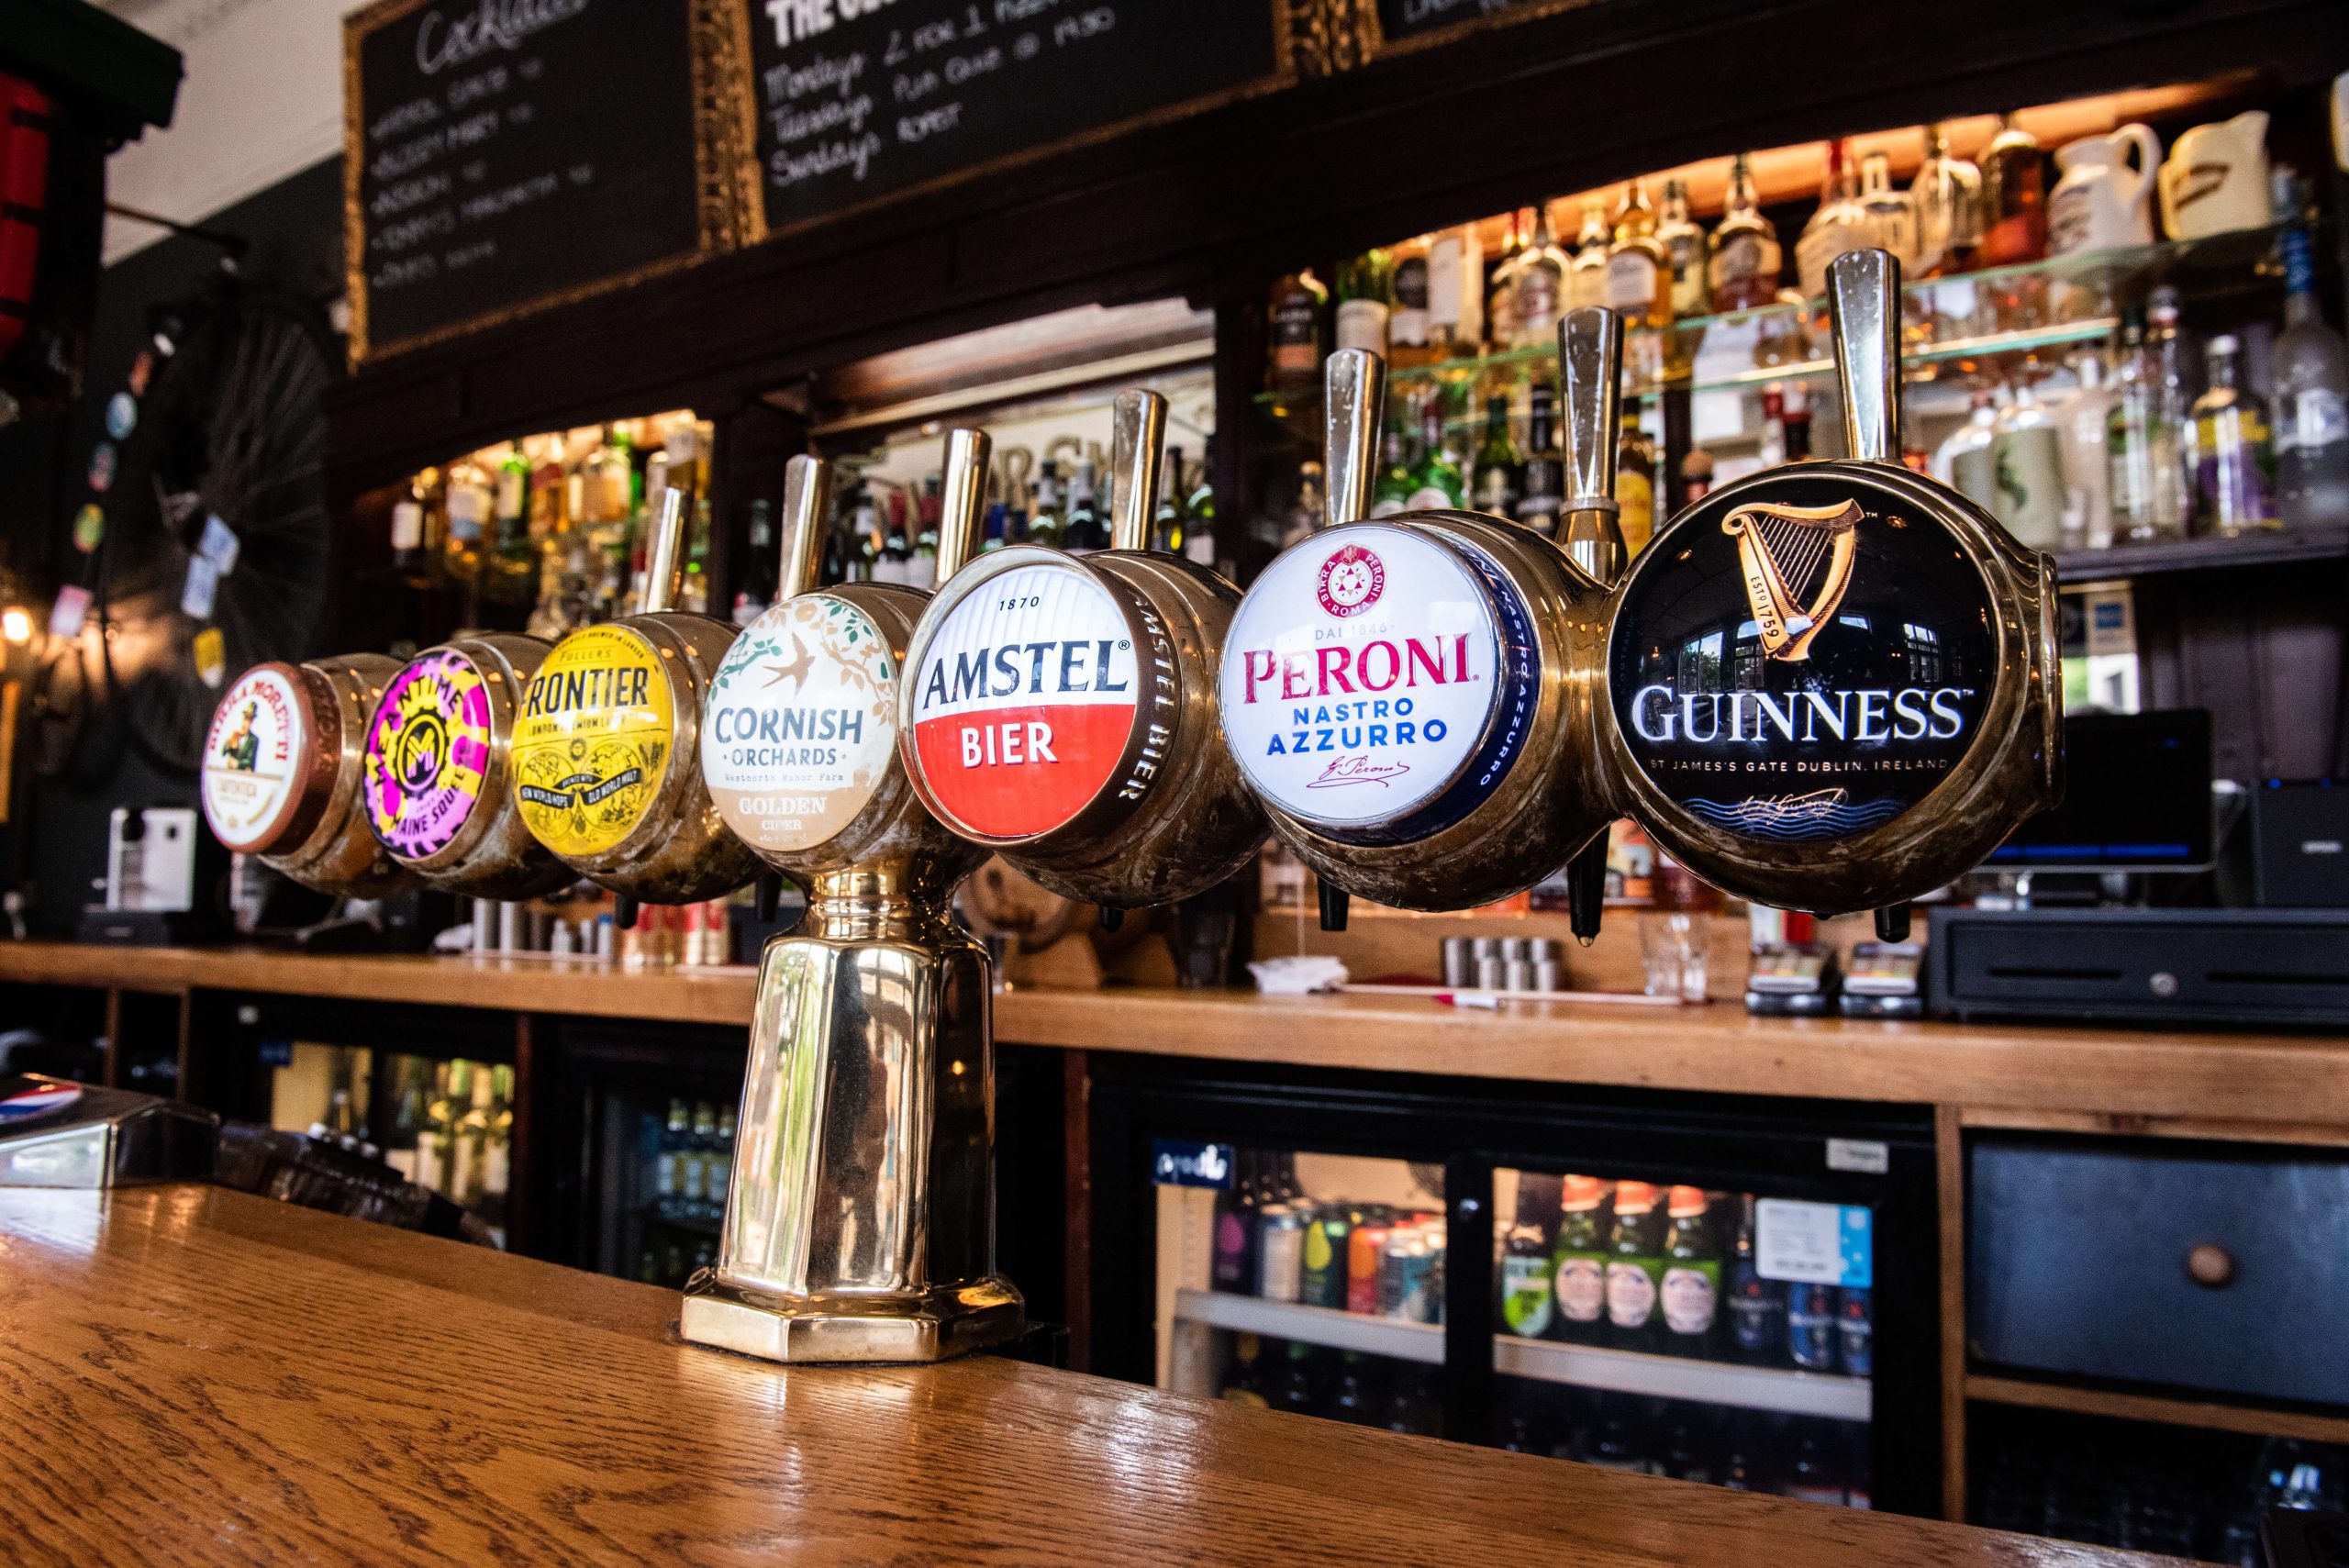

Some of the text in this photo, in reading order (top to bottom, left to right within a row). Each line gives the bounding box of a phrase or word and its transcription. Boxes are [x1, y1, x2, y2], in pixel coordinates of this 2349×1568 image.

[417, 0, 588, 75] Cockta
[764, 0, 836, 47] THE
[1319, 553, 1384, 603] BIRRA PERONI
[998, 596, 1040, 611] 1870
[1330, 601, 1370, 617] ROMA
[1756, 605, 1779, 639] 1759
[1315, 627, 1342, 640] DAL
[1501, 590, 1529, 676] NASTRO
[923, 639, 1129, 710] AMSTEL
[1242, 632, 1472, 705] PERONI
[374, 673, 463, 786] MEANTIME
[561, 718, 599, 732] MIUM
[715, 706, 863, 744] CORNISH
[1293, 697, 1414, 726] NASTRO
[1631, 684, 1965, 742] GUINNESS
[961, 721, 1058, 770] BIER
[1266, 718, 1447, 756] AZZURRO
[1480, 683, 1528, 786] AZZURRO
[731, 748, 837, 766] ORCHARDS
[1118, 723, 1171, 800] BIER
[1651, 759, 1664, 769] ST
[1673, 760, 1737, 772] JAMES'S
[1745, 762, 1788, 772] GATE
[1875, 759, 1947, 772] IRELAND
[819, 773, 843, 782] Farm
[739, 796, 828, 815] GOLDEN
[762, 819, 803, 830] CIDER
